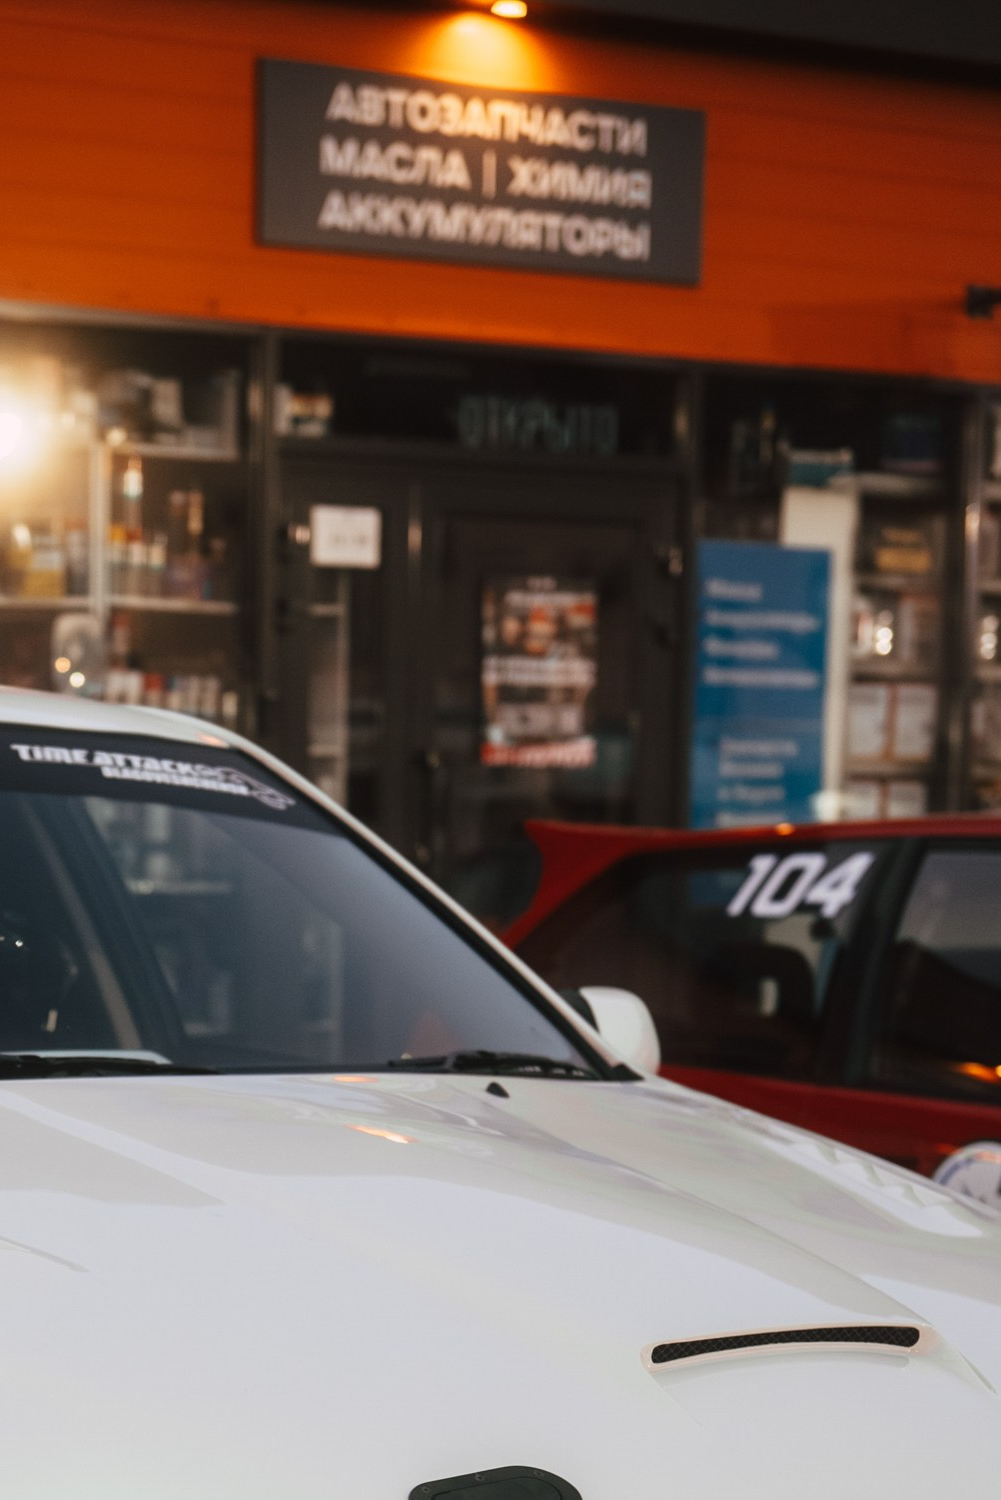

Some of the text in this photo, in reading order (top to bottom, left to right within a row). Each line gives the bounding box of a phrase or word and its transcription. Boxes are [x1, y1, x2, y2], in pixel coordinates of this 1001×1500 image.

[325, 82, 648, 158] АВТОЗАПЧАСТИ
[319, 134, 652, 210] МАСЛА ХИМИЯ
[317, 190, 651, 262] АККУМУЛЯТОРЫ
[726, 852, 875, 918] 104
